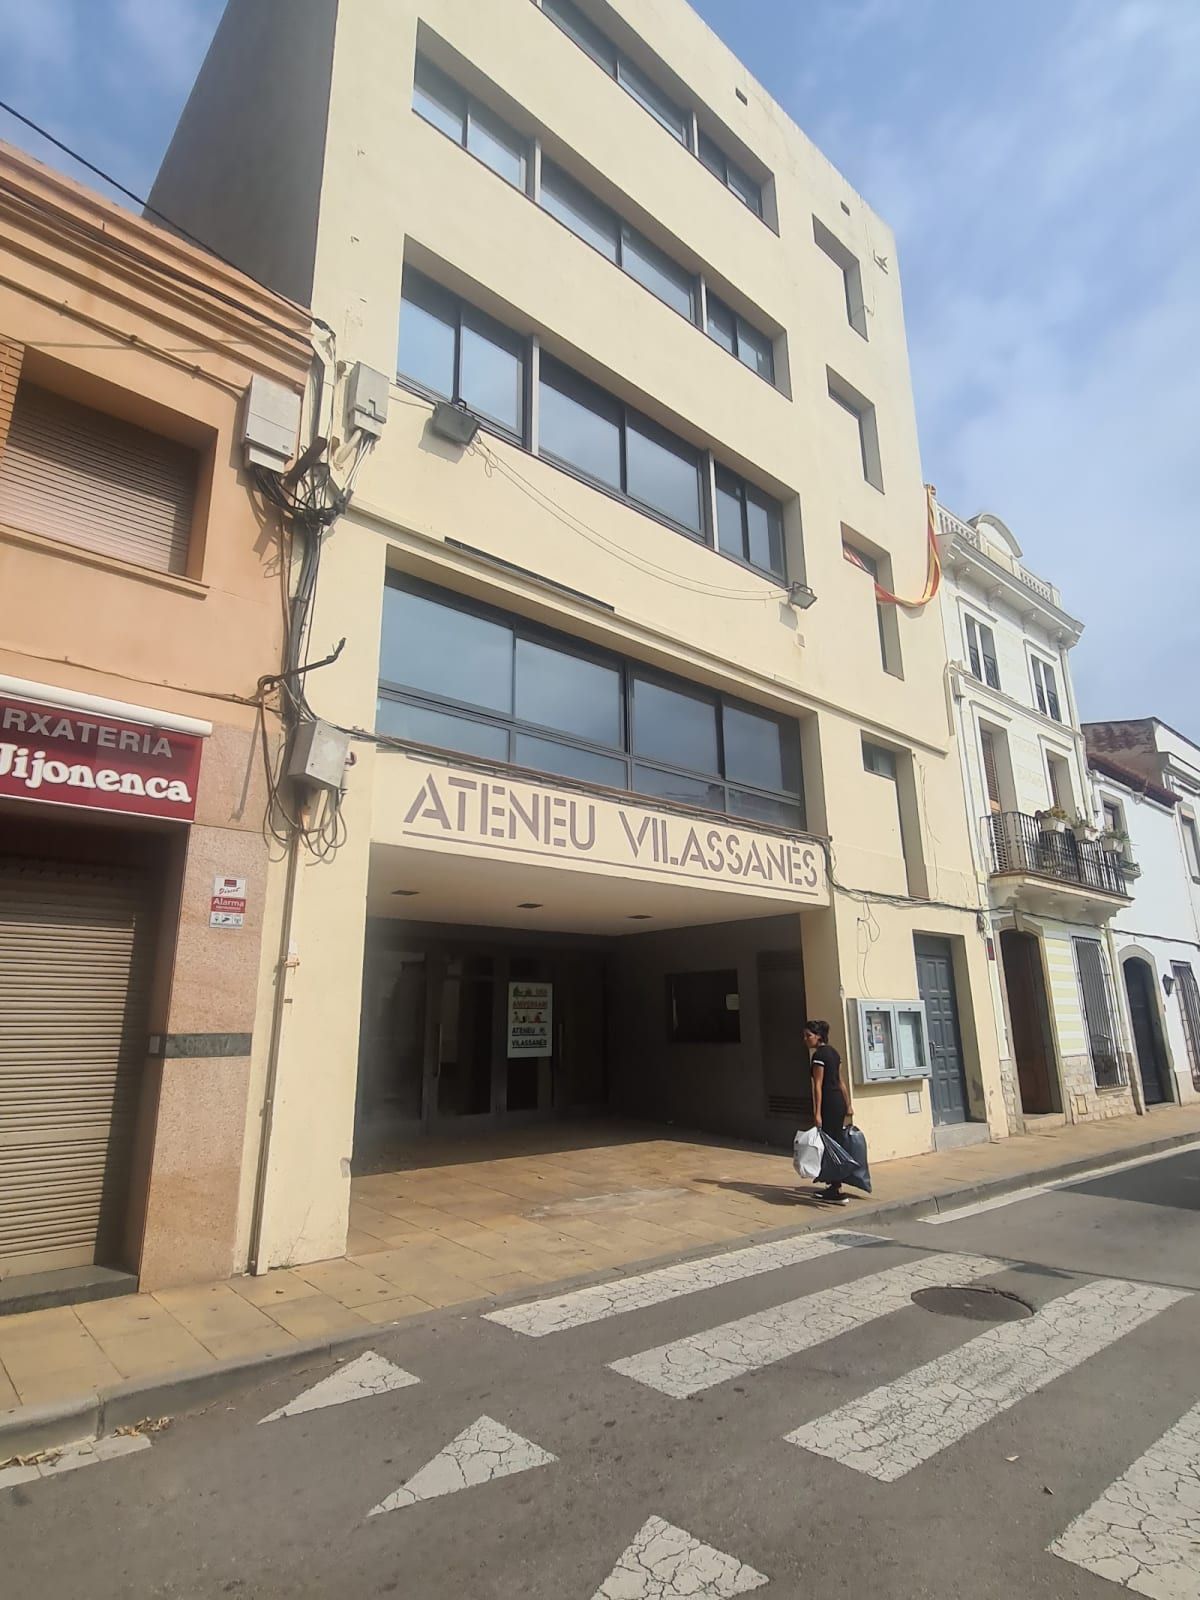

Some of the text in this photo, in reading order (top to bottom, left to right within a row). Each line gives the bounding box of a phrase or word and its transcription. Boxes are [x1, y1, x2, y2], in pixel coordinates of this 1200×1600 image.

[2, 707, 173, 758] RXATERIA
[403, 773, 818, 888] ATENEU VILASSANÈS
[212, 897, 245, 907] Alarma
